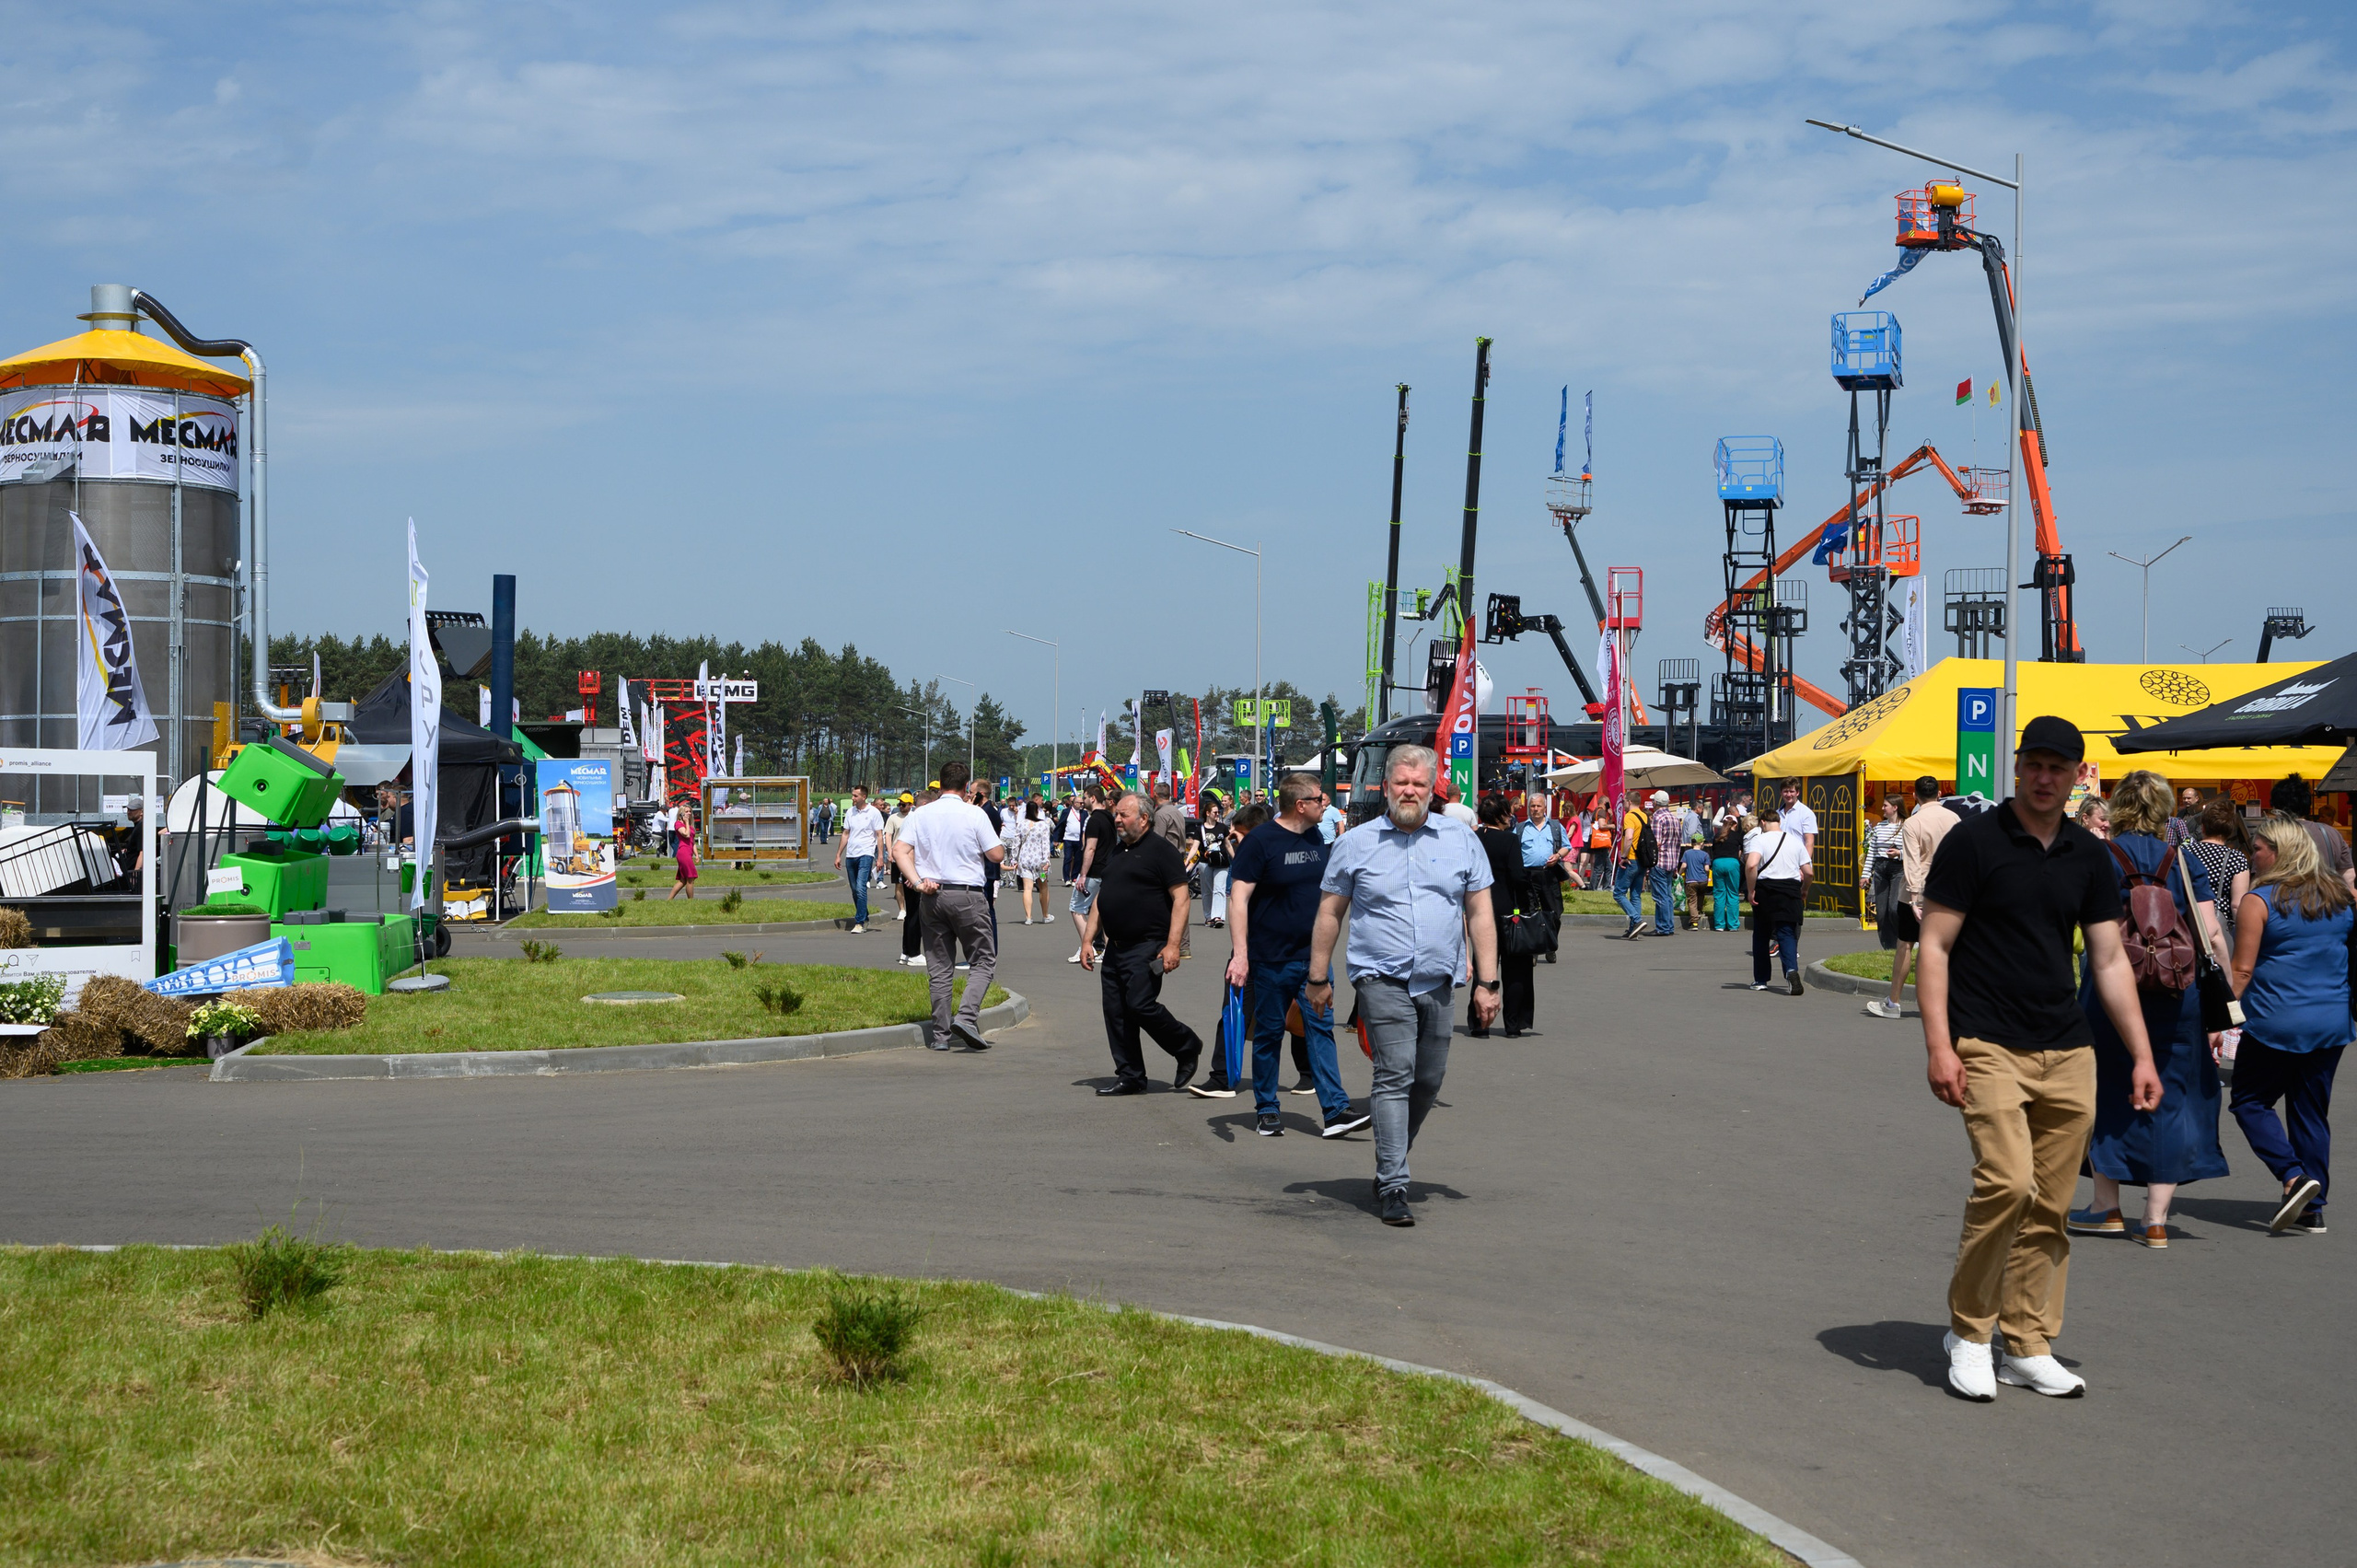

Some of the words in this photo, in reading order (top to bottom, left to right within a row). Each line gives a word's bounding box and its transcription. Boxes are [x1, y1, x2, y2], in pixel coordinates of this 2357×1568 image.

[0, 413, 110, 447] ECMAR
[130, 413, 238, 459] MECMAR
[1972, 700, 1987, 720] P
[2234, 693, 2319, 713] GORILLA
[1459, 739, 1468, 751] P
[570, 766, 608, 775] MECMAR
[1240, 764, 1247, 773] P
[1968, 753, 1987, 777] N
[1457, 770, 1469, 784] N
[211, 876, 239, 884] PROMIS
[231, 969, 277, 982] PROMIS
